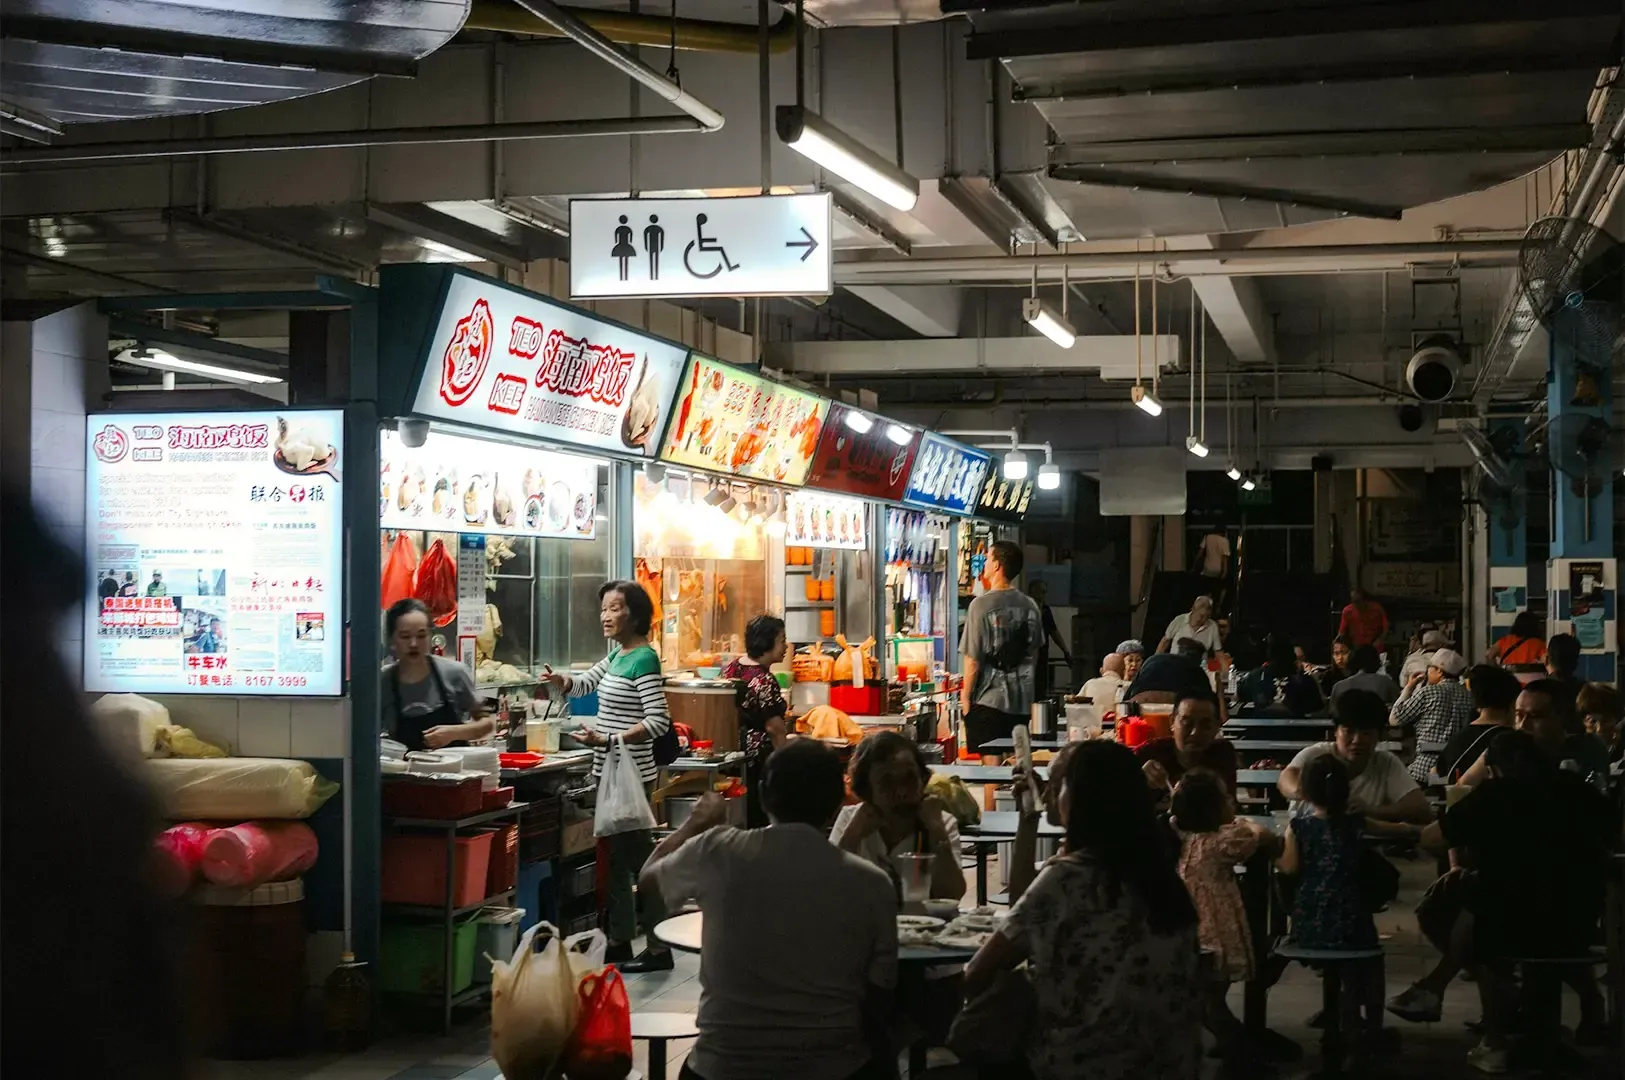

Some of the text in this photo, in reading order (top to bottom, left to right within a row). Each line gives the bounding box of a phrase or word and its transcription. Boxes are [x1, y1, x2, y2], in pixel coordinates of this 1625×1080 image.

[510, 319, 542, 357] TEO
[536, 331, 634, 405] 海南鸡饭
[489, 375, 526, 412] KEE
[168, 424, 268, 449] 海南鸡饭
[250, 485, 325, 503] 联合早报
[187, 656, 227, 670] 牛车水
[245, 675, 273, 687] 8167
[278, 676, 307, 688] 3999
